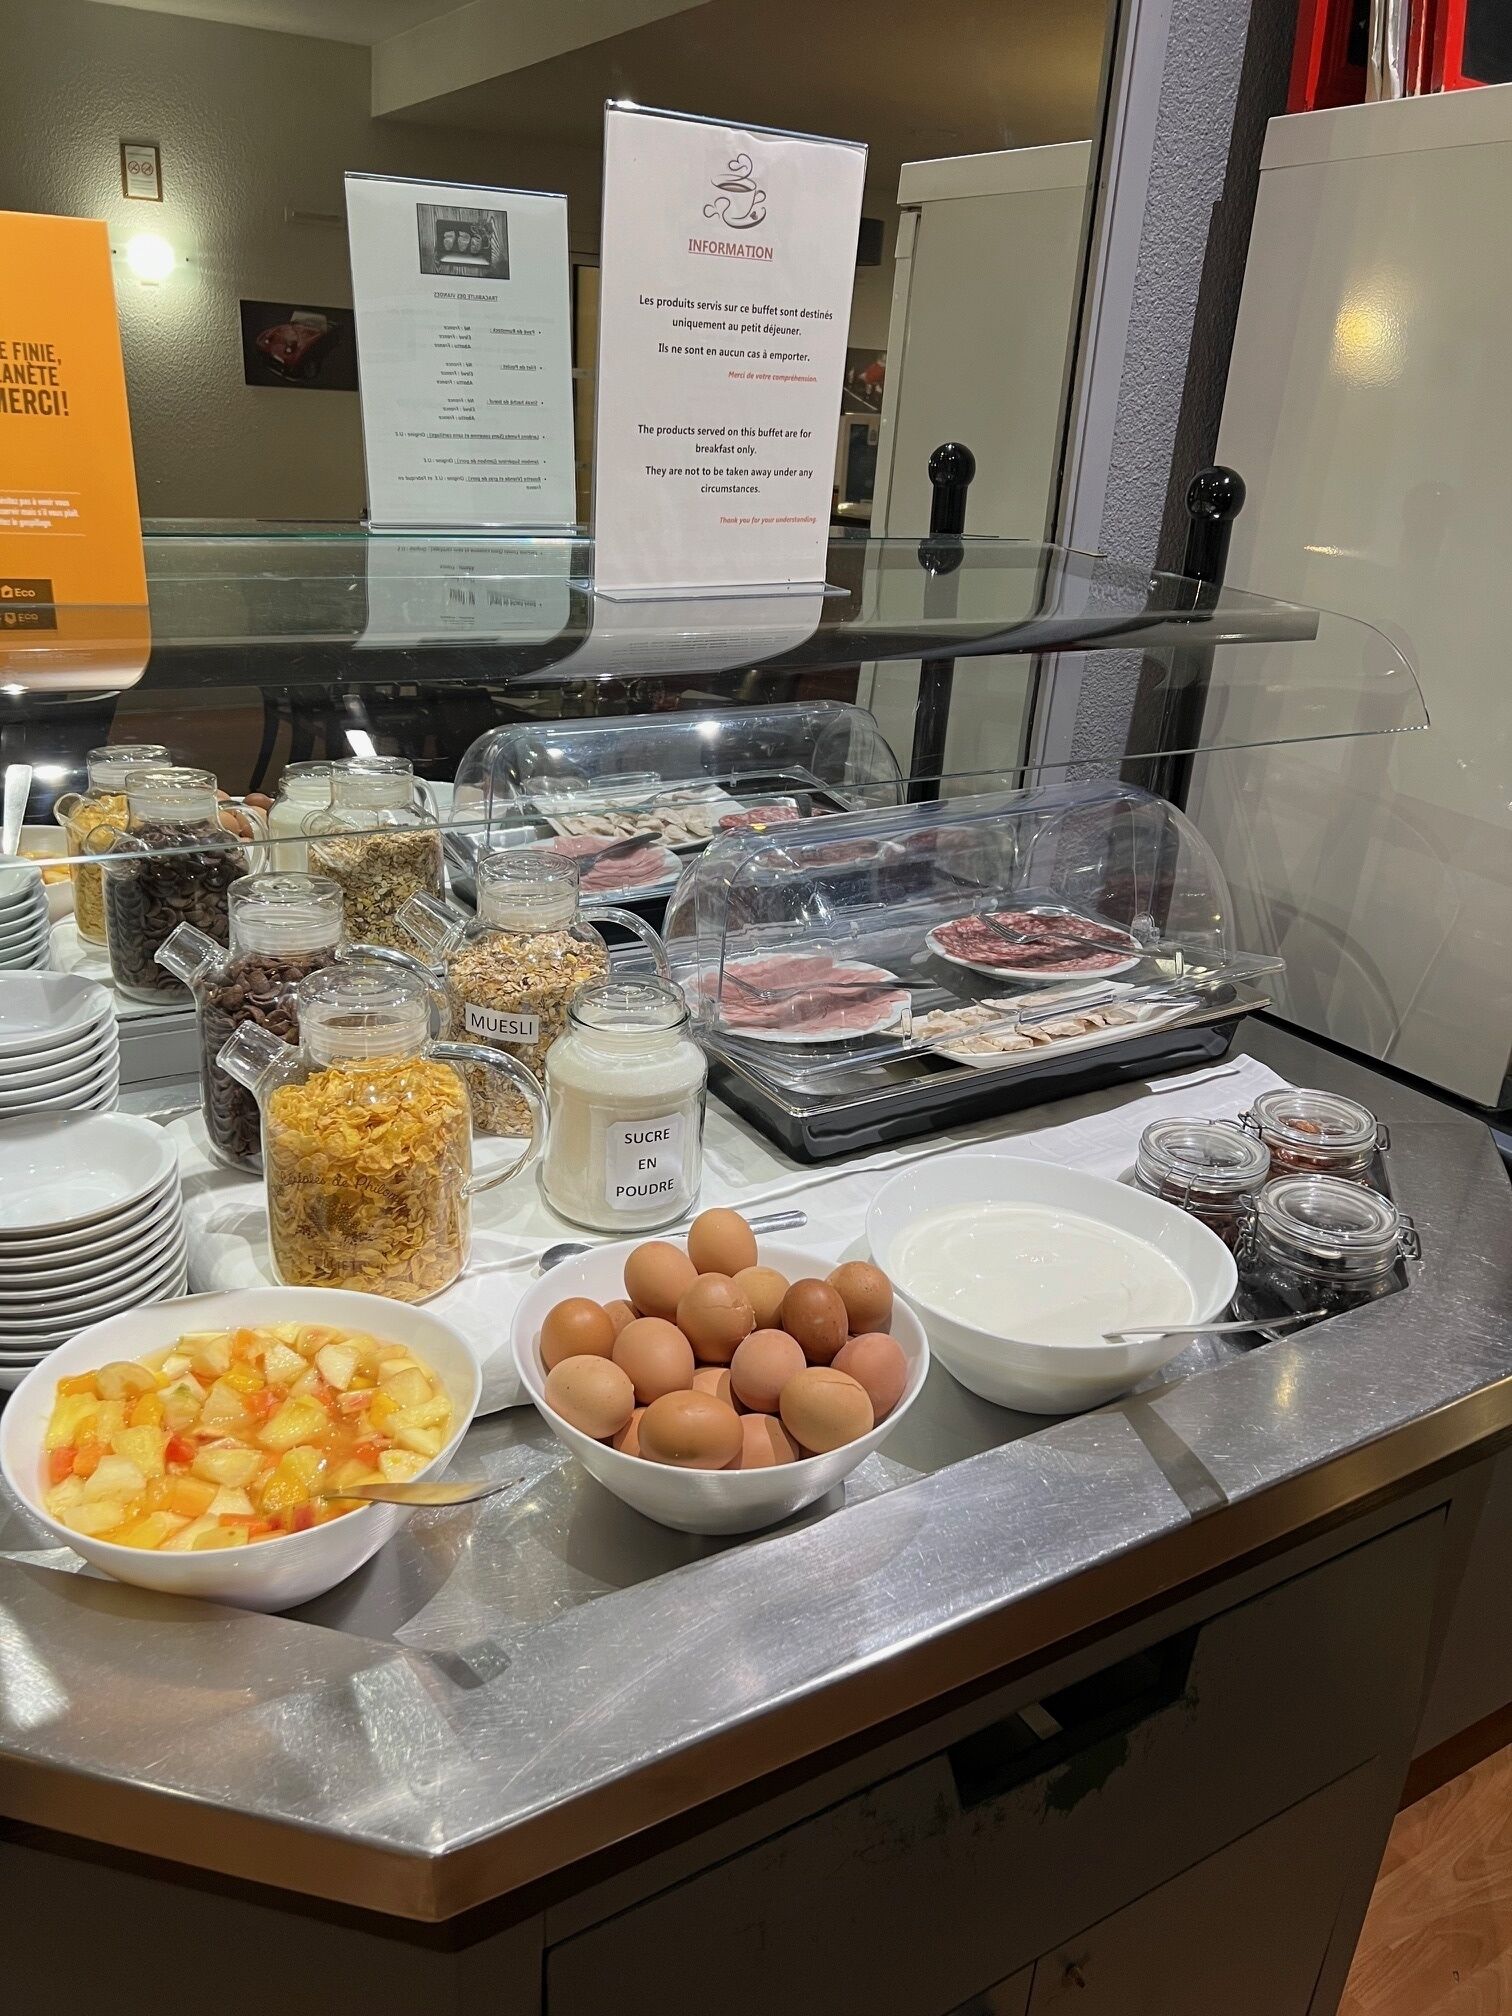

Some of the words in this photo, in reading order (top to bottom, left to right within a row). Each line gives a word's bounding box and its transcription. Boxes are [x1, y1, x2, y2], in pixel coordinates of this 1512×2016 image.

[688, 239, 773, 260] INFORMATION
[639, 295, 654, 305] Les
[657, 297, 695, 309] produits
[697, 301, 722, 311] servis
[724, 304, 738, 313] sur
[740, 305, 749, 313] ce
[752, 304, 778, 316] buffet
[780, 309, 798, 317] sont
[800, 309, 833, 320] destinés
[672, 318, 725, 330] uniquement
[728, 323, 738, 331] au
[741, 322, 761, 334] petit
[763, 324, 801, 336] déjeuner.
[13, 341, 62, 366] FINIE,
[658, 343, 669, 353] Ils
[672, 345, 682, 354] ne
[685, 346, 704, 355] sont
[706, 348, 716, 356] en
[719, 349, 744, 358] aucun
[747, 350, 760, 358] cas
[762, 350, 767, 358] à
[770, 352, 810, 362] emporter.
[0, 362, 59, 386] ANÈTE
[773, 373, 817, 382] compréhension.
[638, 425, 654, 434] The
[657, 425, 695, 436] products
[697, 427, 725, 436] served
[741, 427, 755, 436] this
[758, 428, 783, 438] buffet
[785, 430, 797, 438] are
[800, 429, 811, 438] for
[695, 444, 734, 454] breakfast
[737, 445, 757, 456] only.
[646, 466, 667, 477] They
[669, 468, 682, 476] are
[685, 467, 699, 476] not
[702, 468, 711, 476] to
[713, 467, 724, 476] be
[726, 467, 748, 476] taken
[751, 469, 771, 478] away
[773, 468, 797, 477] under
[799, 470, 813, 478] any
[701, 484, 760, 493] circumstances.
[14, 588, 36, 597] Eco
[471, 1013, 532, 1035] MUESLI
[624, 1128, 670, 1144] SUCRE
[638, 1158, 657, 1170] EN
[332, 1173, 349, 1187] de
[617, 1178, 674, 1197] POUDRE
